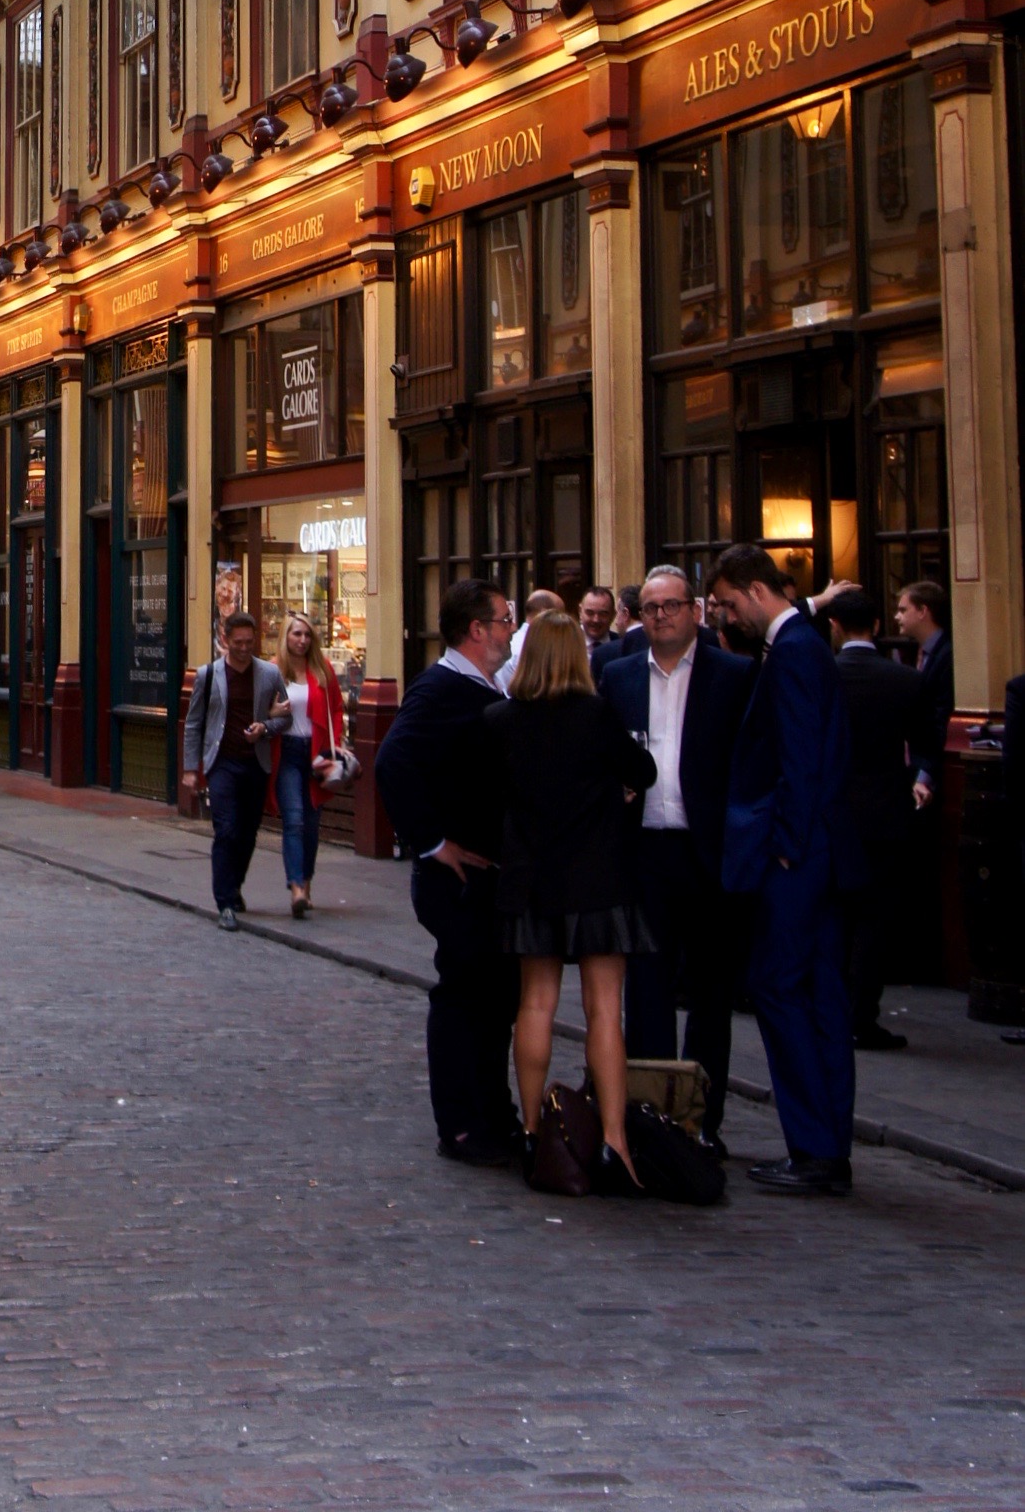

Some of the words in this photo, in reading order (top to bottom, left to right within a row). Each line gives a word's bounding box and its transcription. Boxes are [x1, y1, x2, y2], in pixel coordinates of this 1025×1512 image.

[683, 43, 740, 103] ALES
[744, 40, 764, 79] &
[438, 147, 481, 195] NEW
[483, 123, 544, 180] MOON
[252, 229, 283, 260] CARDS
[284, 213, 324, 249] GALORE
[219, 253, 228, 274] 16
[112, 280, 158, 315] CHAMPAGNE
[7, 336, 20, 356] FINE
[21, 327, 43, 351] SPIRITS
[284, 357, 316, 389] CARDS
[282, 388, 319, 420] GALORE
[299, 519, 337, 553] CARDS
